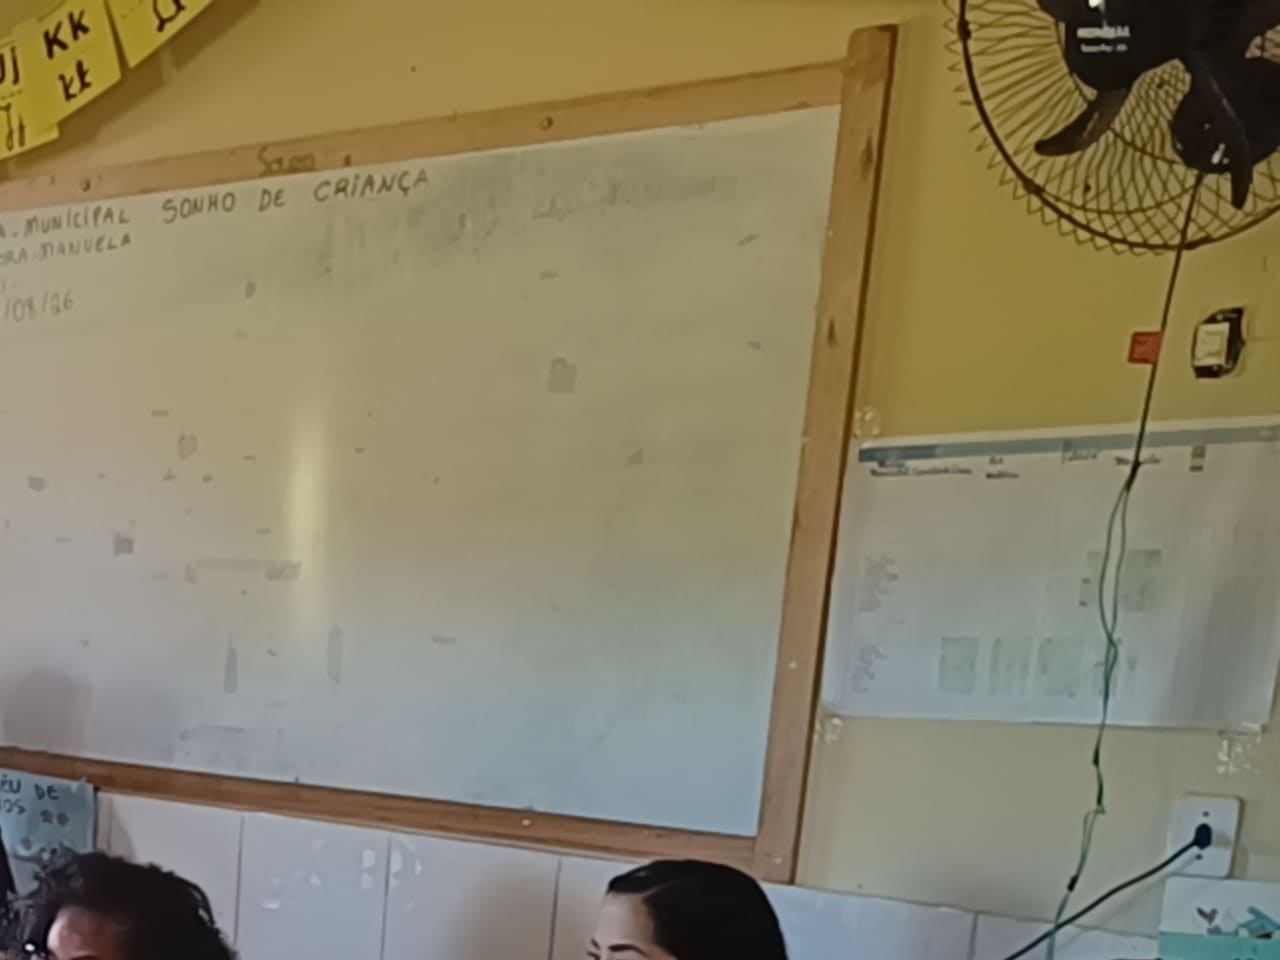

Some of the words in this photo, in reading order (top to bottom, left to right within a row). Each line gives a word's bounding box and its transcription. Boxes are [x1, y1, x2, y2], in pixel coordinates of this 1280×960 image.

[43, 9, 90, 60] Kk
[23, 206, 132, 237] MUNICIPAL
[161, 191, 236, 225] SONHO
[258, 188, 286, 213] DE
[313, 168, 429, 203] CRIANÇA
